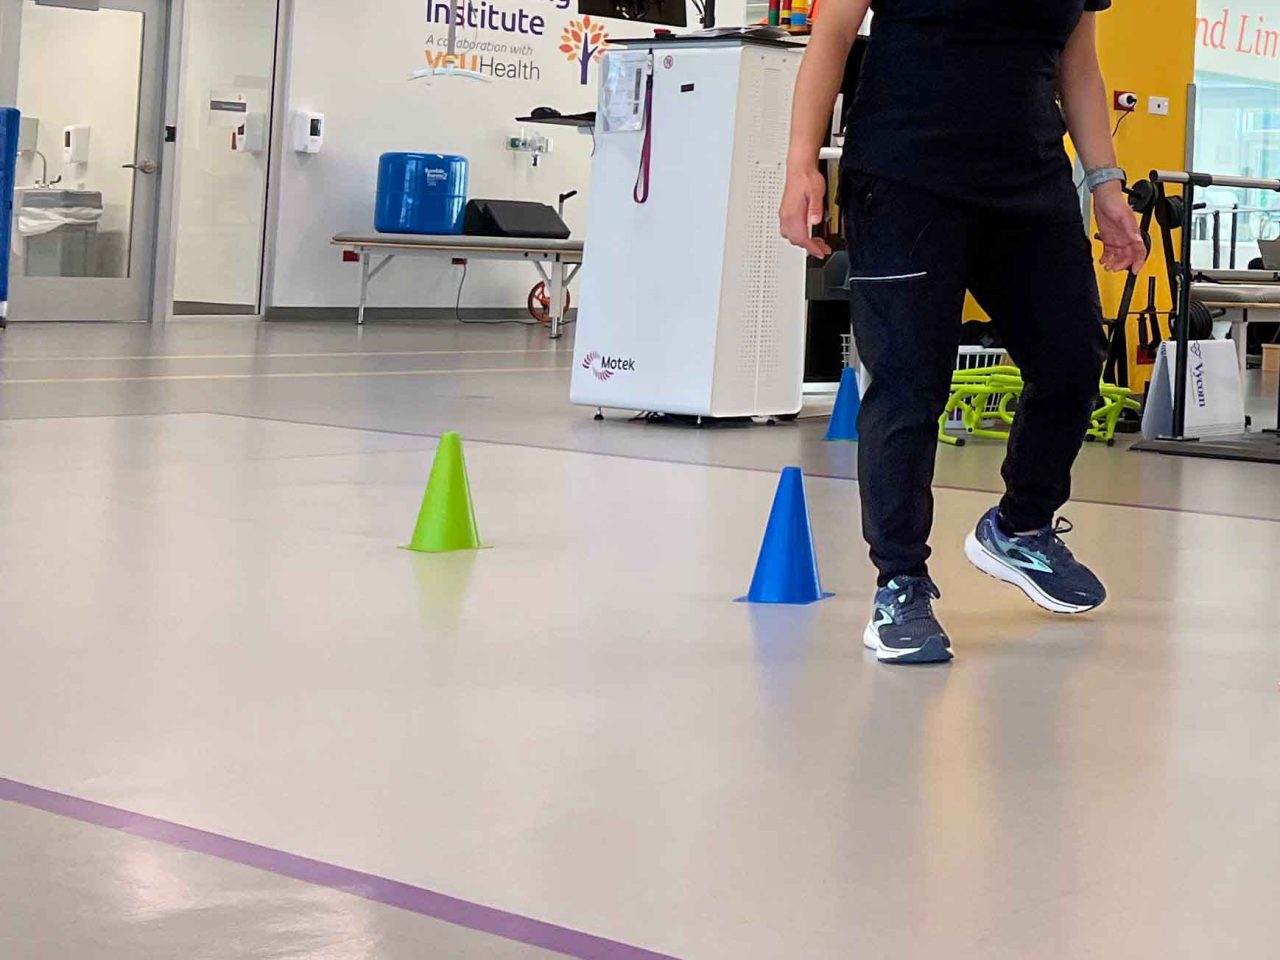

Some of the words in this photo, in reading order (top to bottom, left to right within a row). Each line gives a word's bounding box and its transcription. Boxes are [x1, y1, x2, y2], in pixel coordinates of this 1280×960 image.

[425, 34, 434, 46] A
[437, 36, 507, 53] coaboration
[509, 45, 534, 57] with
[601, 356, 636, 371] Motek
[1193, 362, 1206, 408] Vycom
